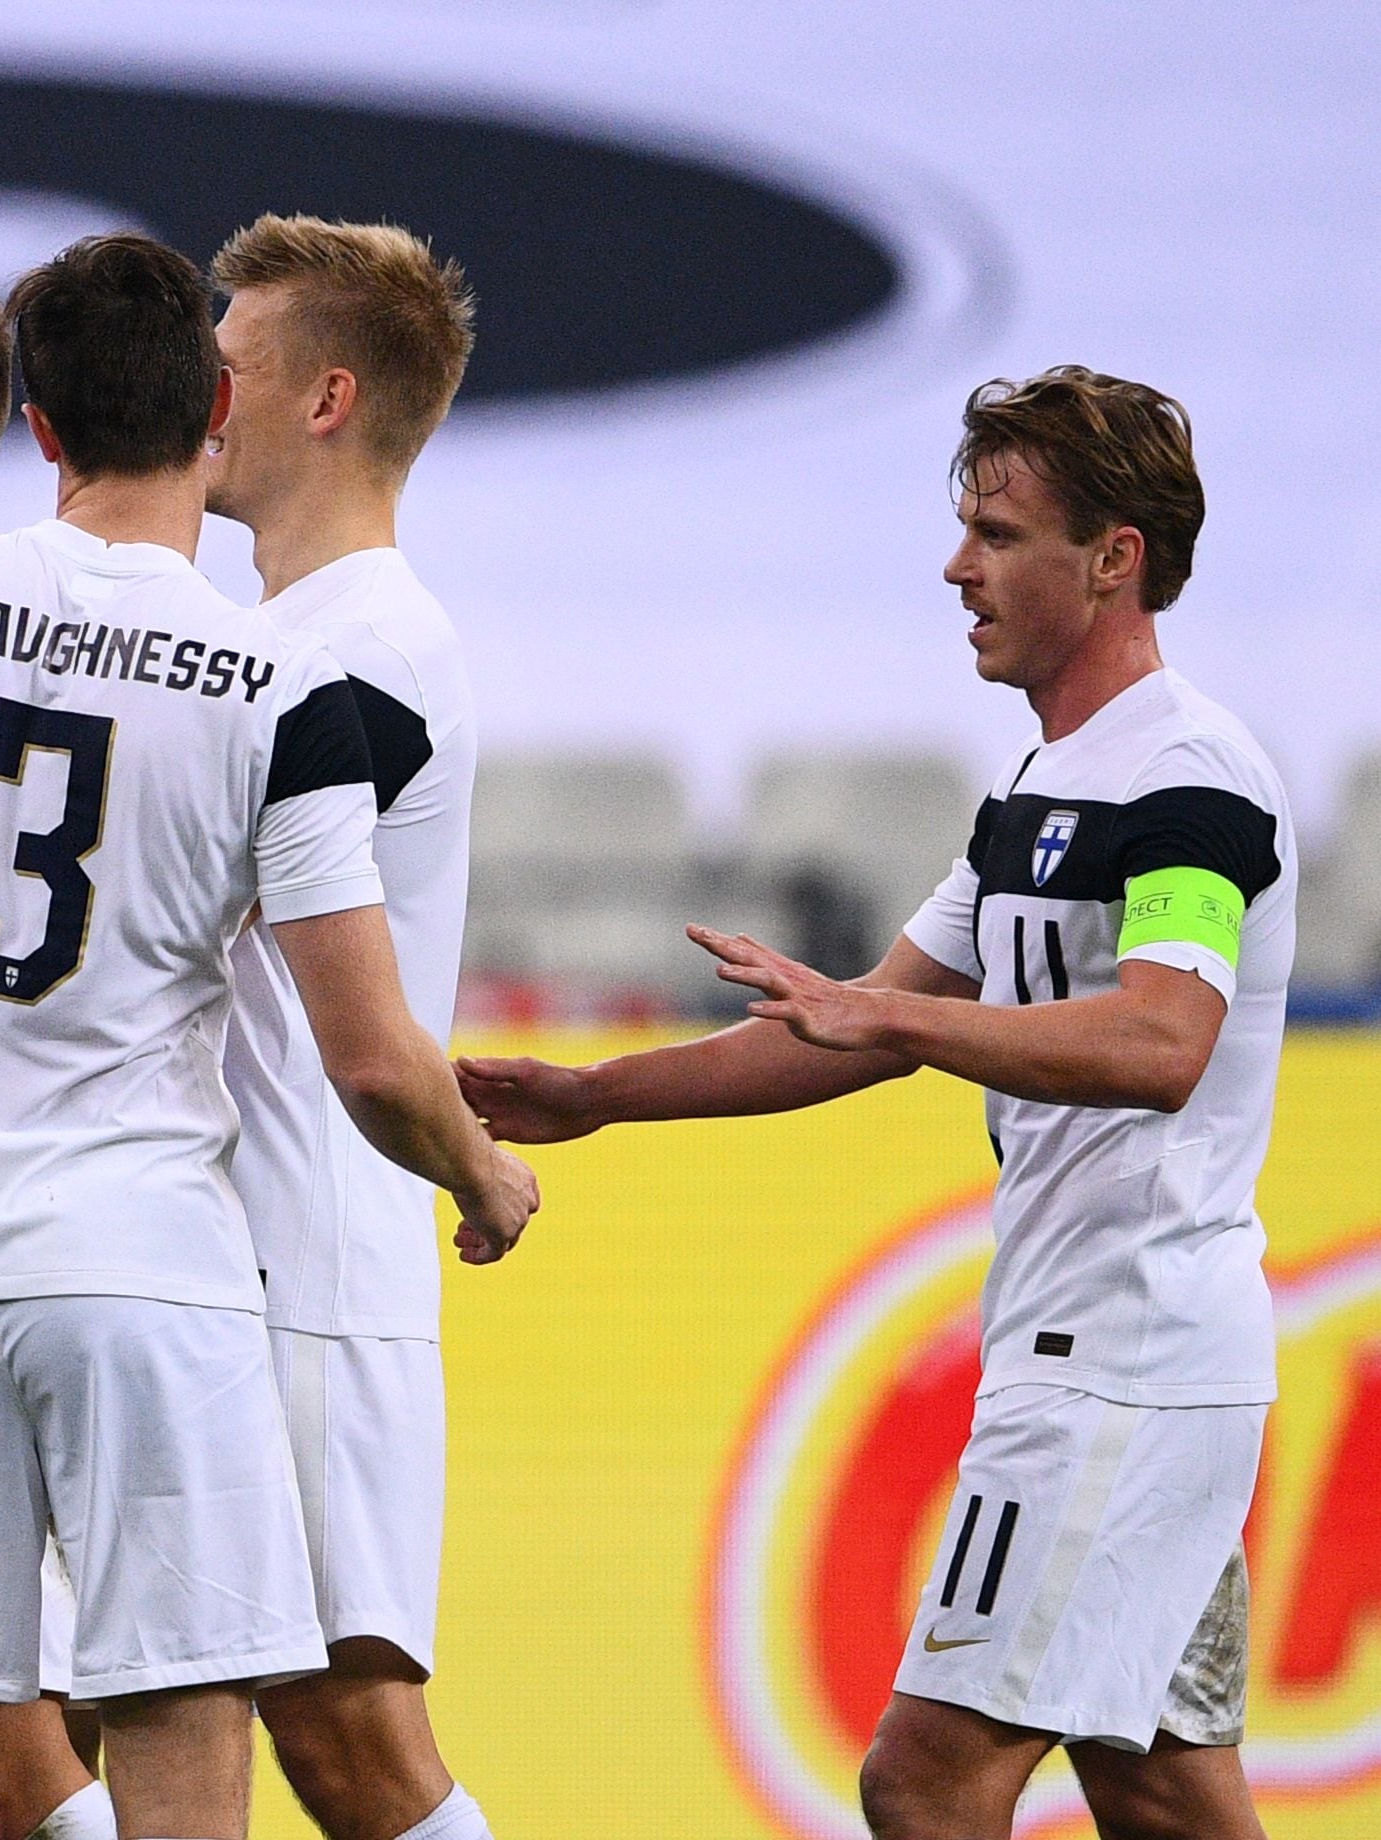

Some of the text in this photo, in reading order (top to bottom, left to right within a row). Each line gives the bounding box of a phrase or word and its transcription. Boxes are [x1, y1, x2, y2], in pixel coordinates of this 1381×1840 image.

[1125, 896, 1173, 921] PECT
[1013, 914, 1069, 1006] 11
[939, 1494, 1021, 1617] 11
